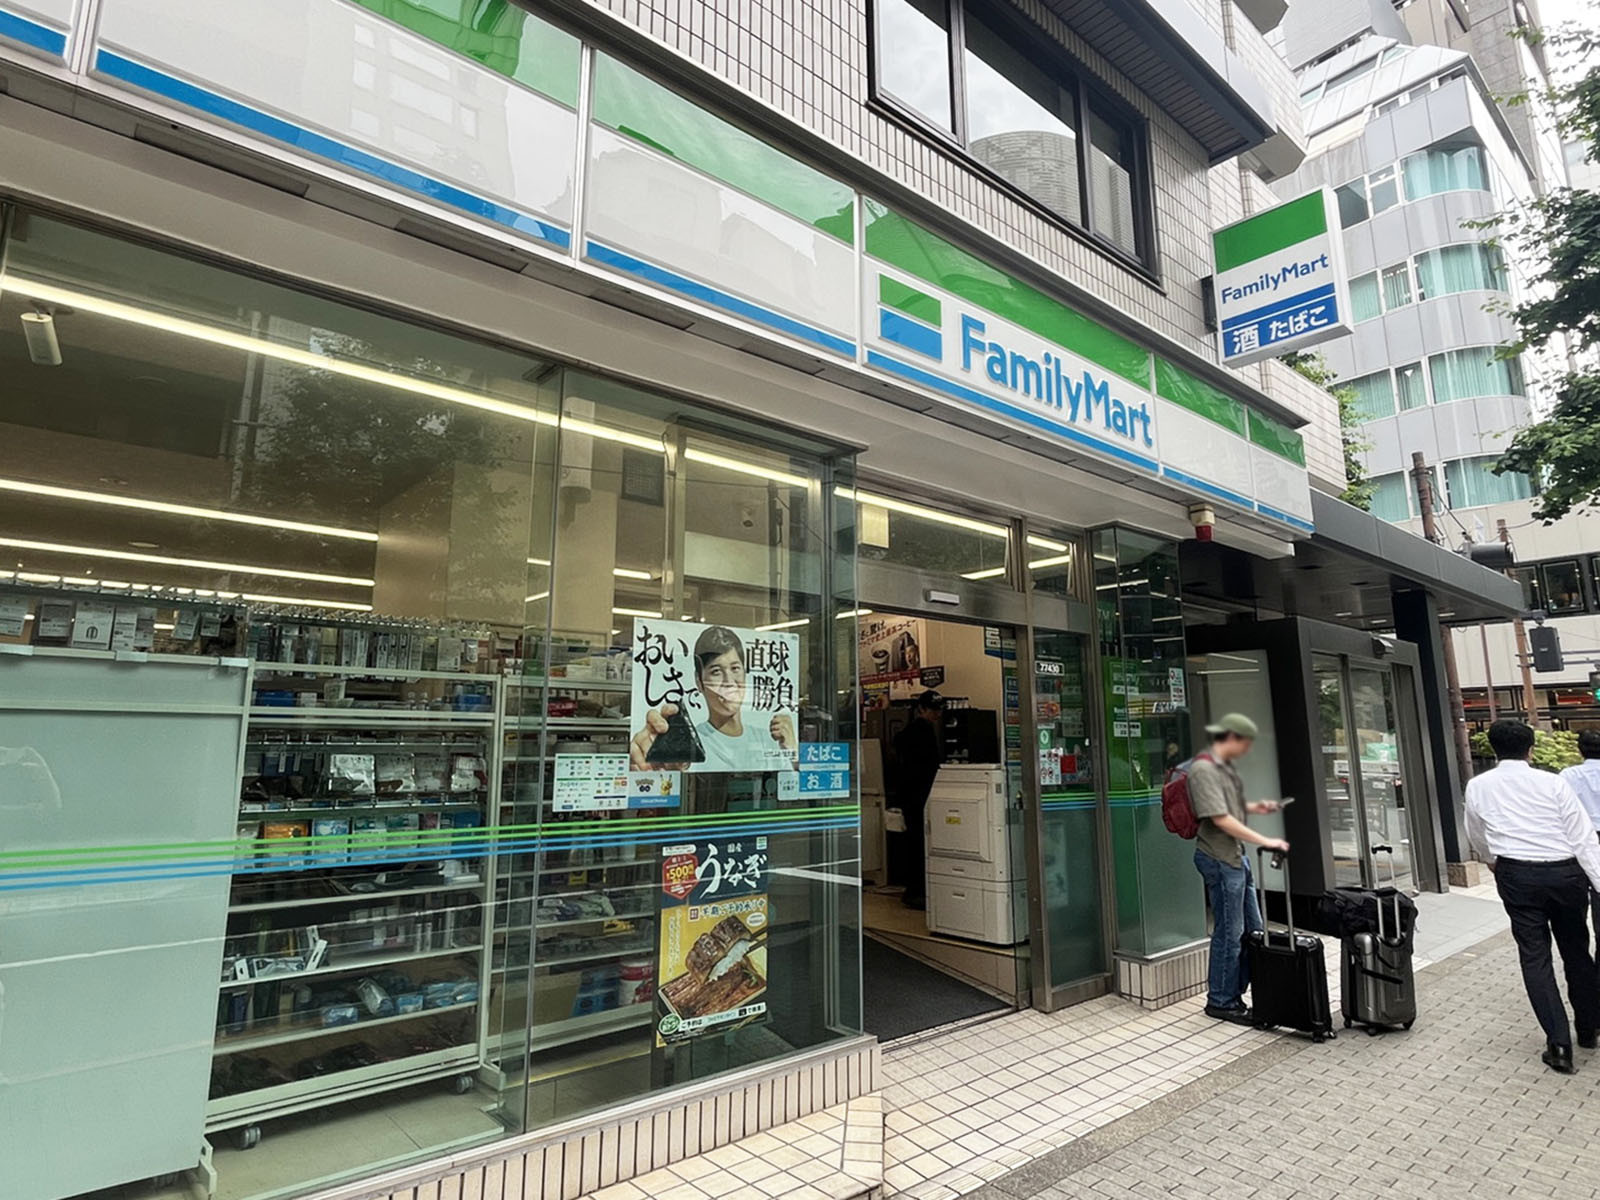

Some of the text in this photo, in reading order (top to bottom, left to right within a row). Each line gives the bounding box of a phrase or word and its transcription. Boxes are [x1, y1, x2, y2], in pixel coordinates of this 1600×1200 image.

[1221, 253, 1328, 304] FamilyMart
[1232, 305, 1328, 354] 酒 たばこ
[960, 313, 1153, 448] FamilyMart
[745, 638, 790, 676] 直球
[806, 744, 842, 761] たばこ
[695, 843, 767, 900] うなぎ
